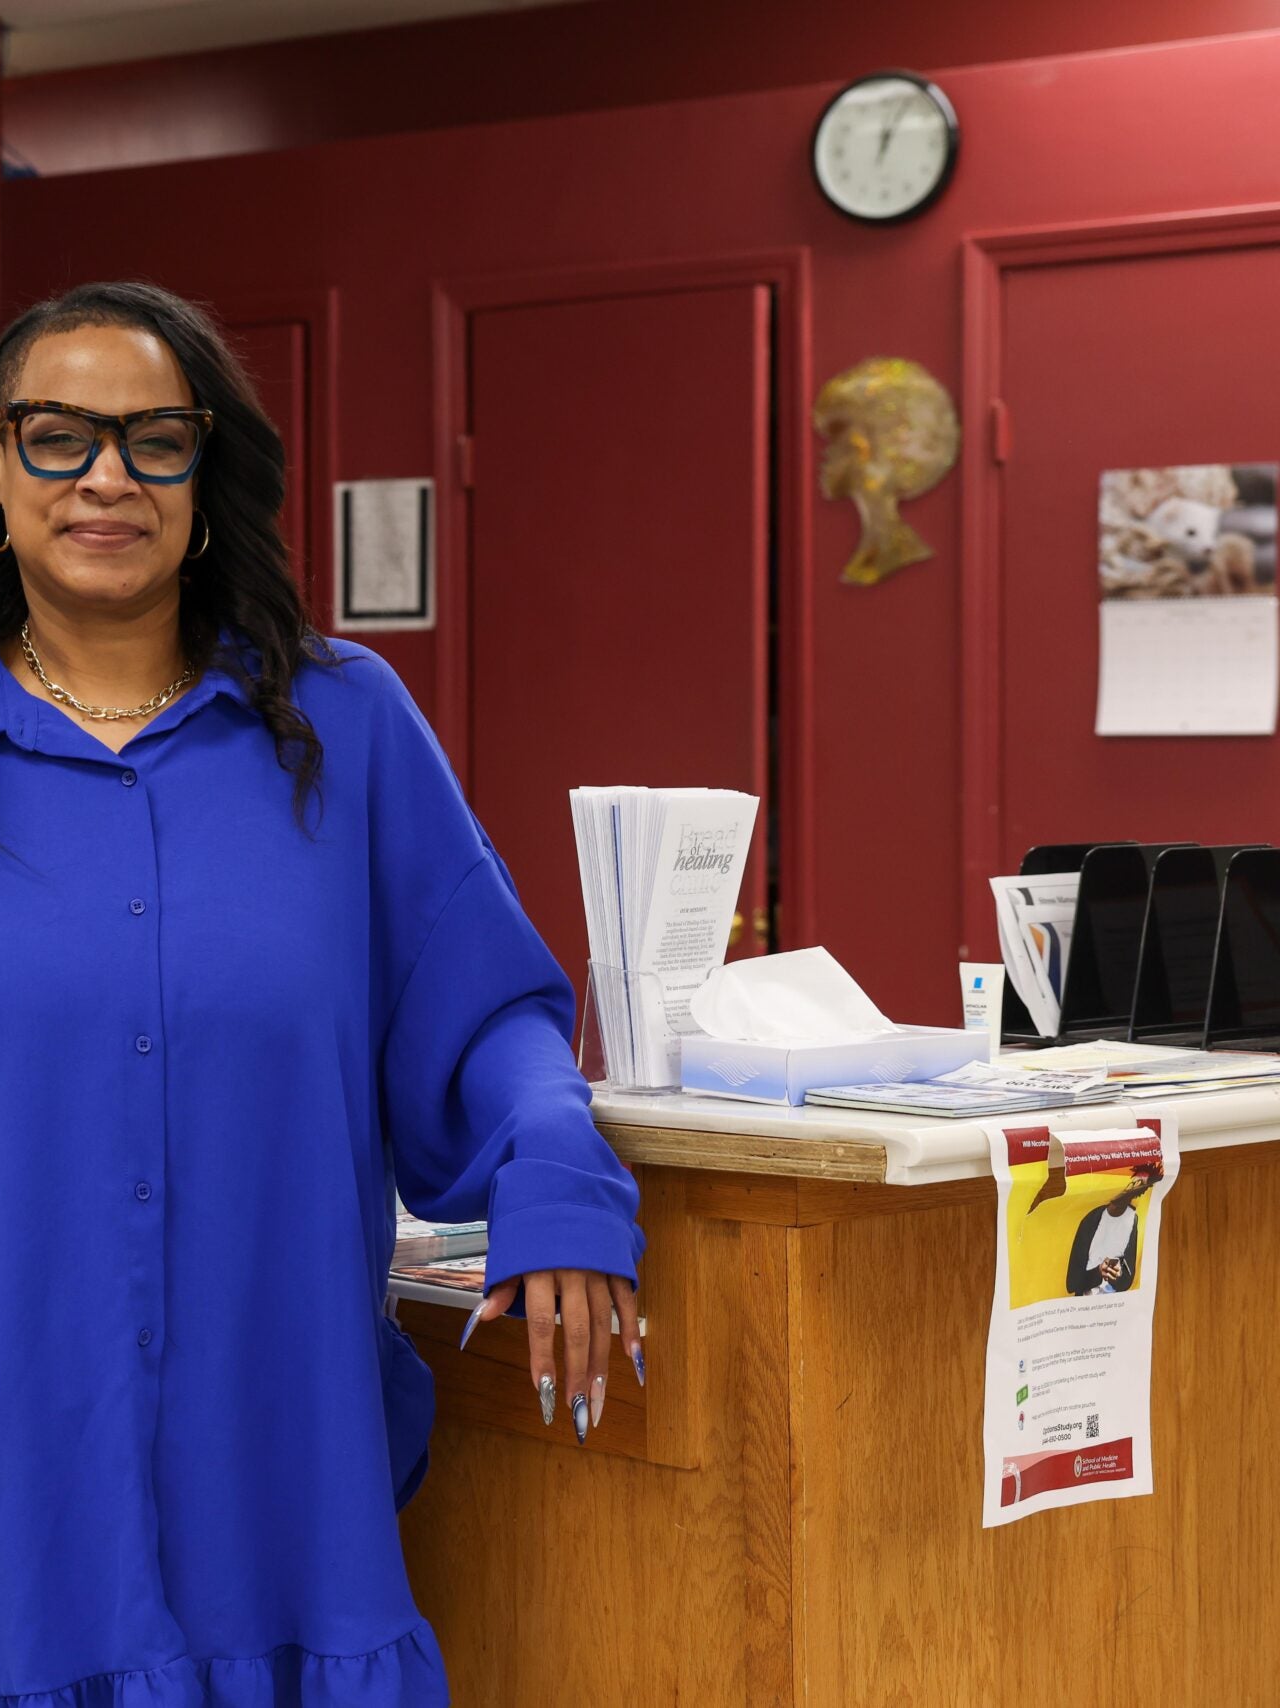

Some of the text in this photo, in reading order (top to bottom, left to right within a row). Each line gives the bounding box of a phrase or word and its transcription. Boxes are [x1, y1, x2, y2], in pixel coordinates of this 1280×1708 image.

[673, 847, 734, 875] healing
[1064, 1154, 1088, 1163] Pouches
[1088, 1153, 1101, 1162] Help
[1100, 1152, 1110, 1160] You
[1110, 1151, 1123, 1160] Wait
[1122, 1151, 1131, 1159] for
[1131, 1150, 1139, 1158] the
[1140, 1149, 1152, 1158] Next
